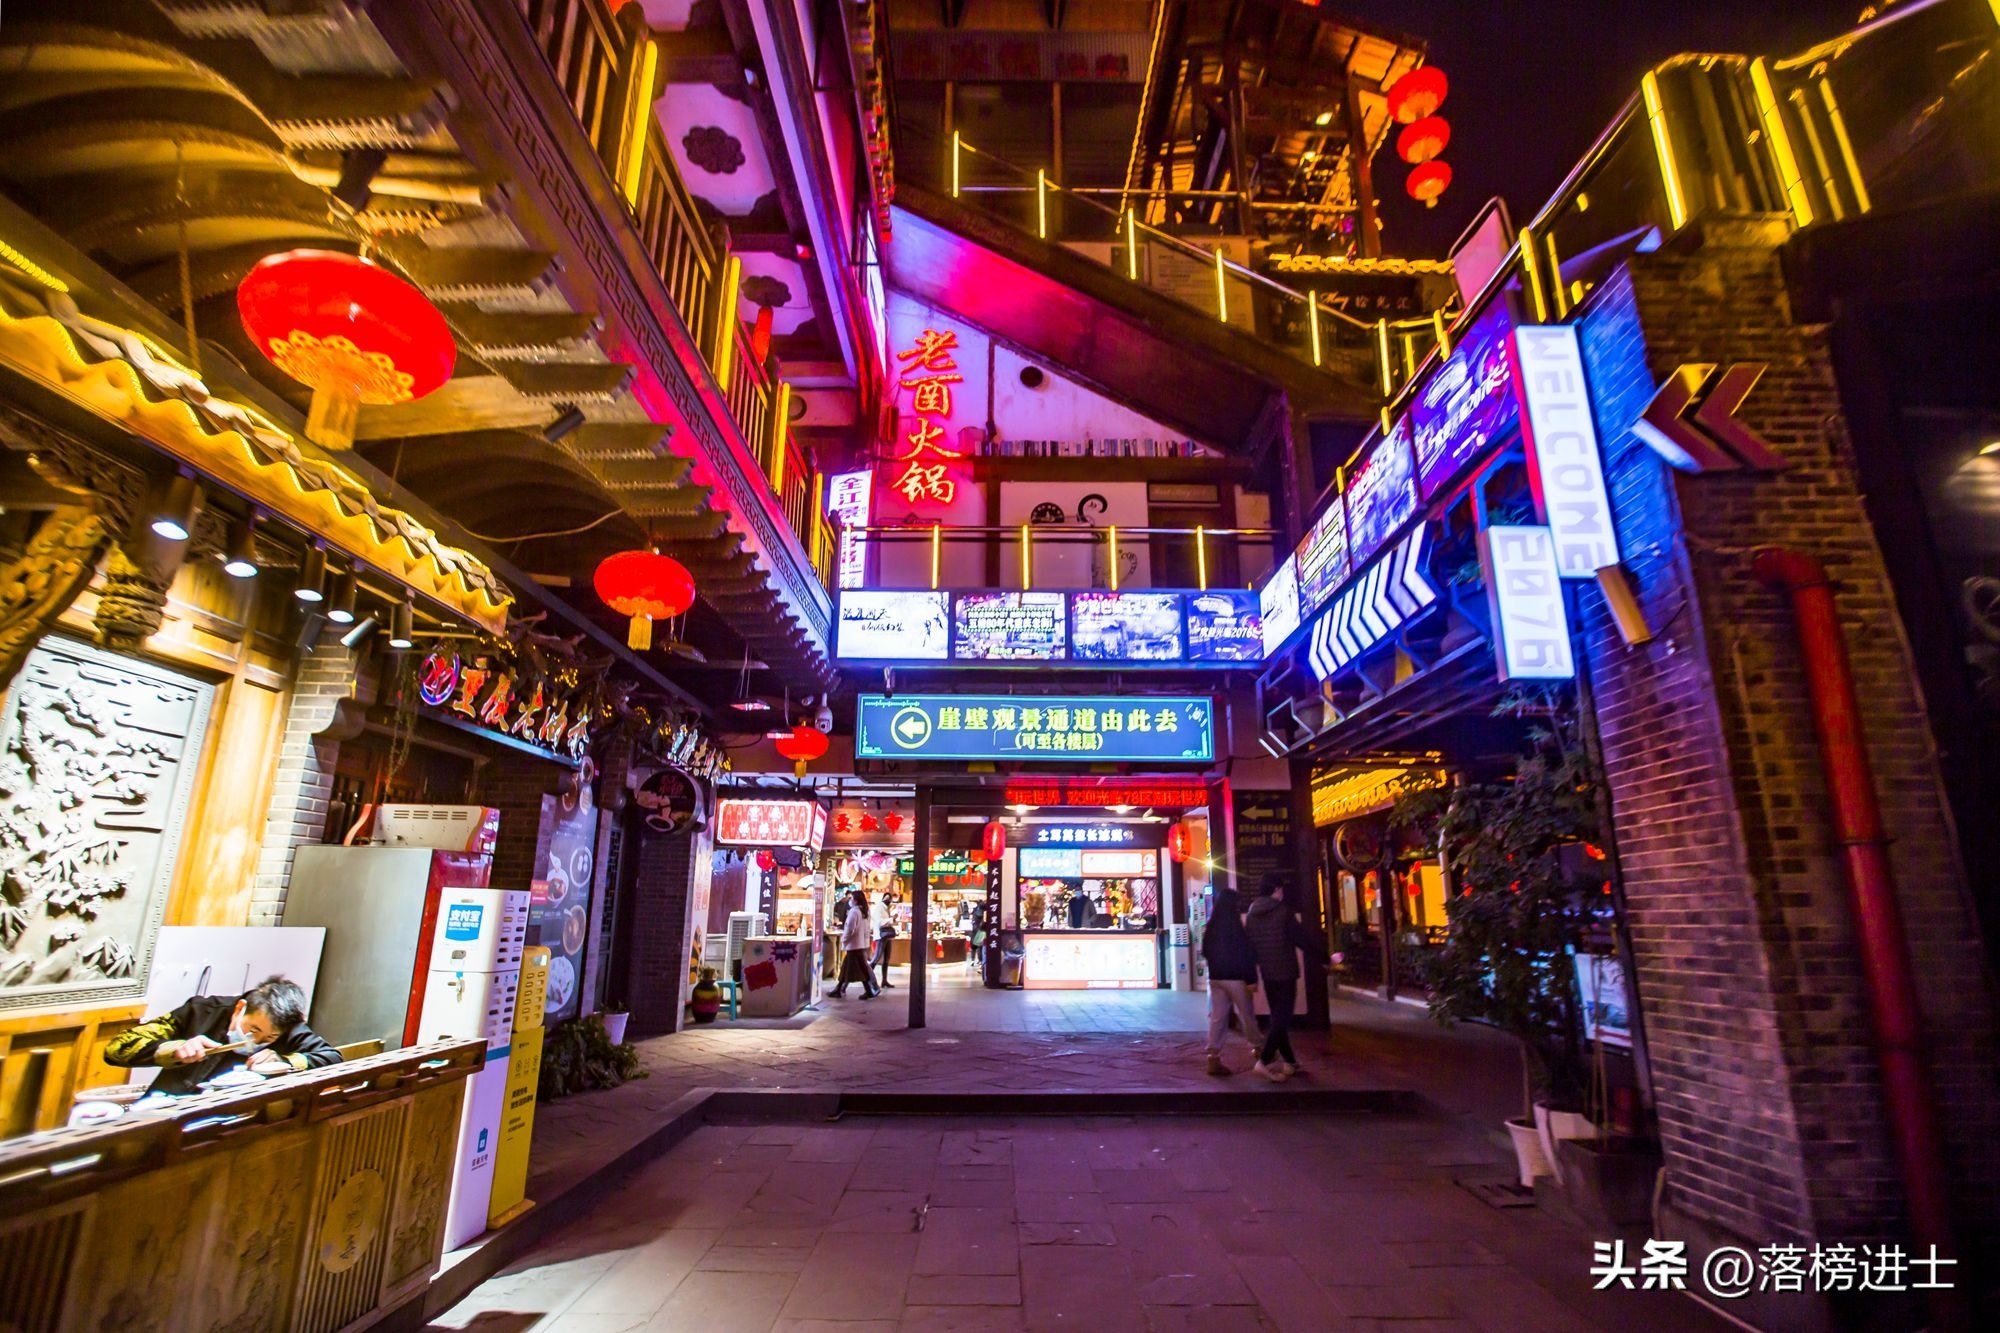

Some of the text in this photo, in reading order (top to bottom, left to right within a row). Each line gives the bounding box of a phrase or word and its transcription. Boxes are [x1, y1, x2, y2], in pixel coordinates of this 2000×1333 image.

[1525, 330, 1608, 570] WELCOME
[1499, 533, 1564, 668] 2076
[936, 706, 1179, 733] 崖壁观景通道由此去
[1013, 732, 1104, 752] (可至各楼层)
[449, 909, 482, 923] 支付宝
